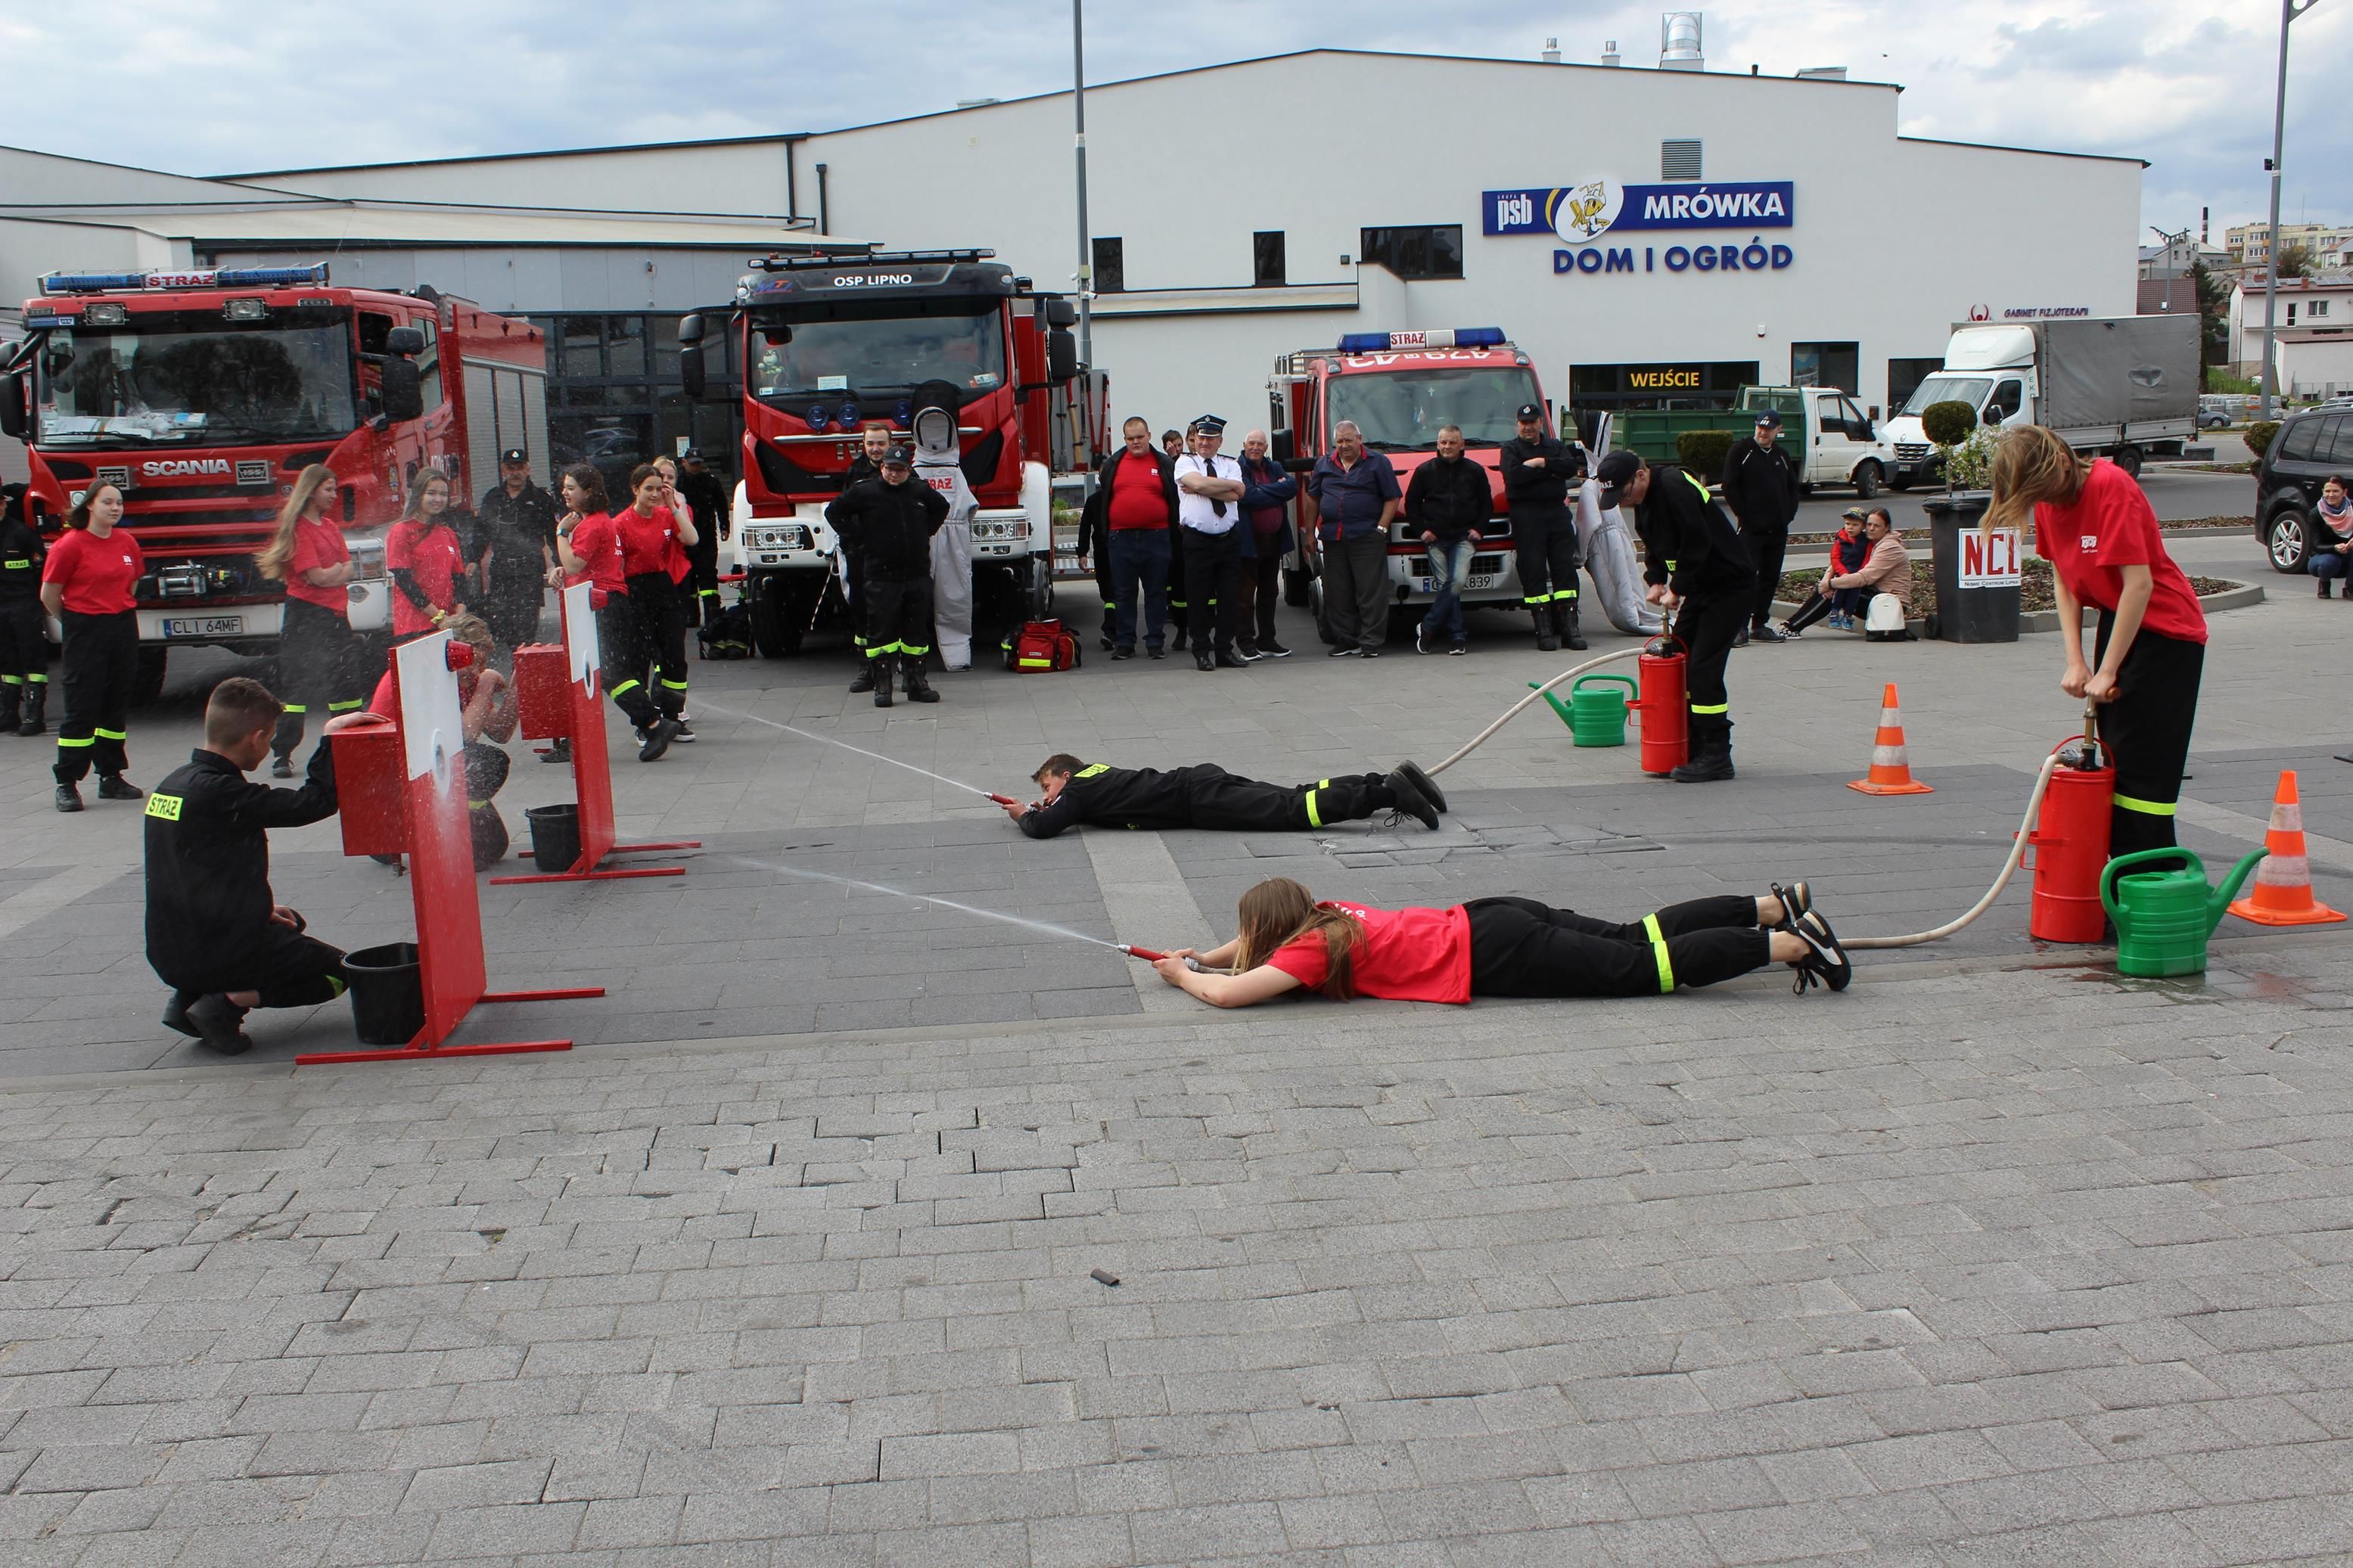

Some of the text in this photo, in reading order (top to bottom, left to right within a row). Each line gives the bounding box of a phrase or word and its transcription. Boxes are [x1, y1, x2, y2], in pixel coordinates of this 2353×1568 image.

[1644, 186, 1786, 220] MRÓWKA
[1553, 236, 1794, 274] DOM I OGRÓD
[834, 274, 912, 287] OSP LIPNO
[2004, 307, 2089, 318] GABINET FIZJOTERAPII
[1630, 368, 1700, 387] WEJŚCIE
[142, 458, 232, 477] SCANIA
[1964, 533, 2019, 576] NCL
[173, 619, 239, 634] CLI 64MF
